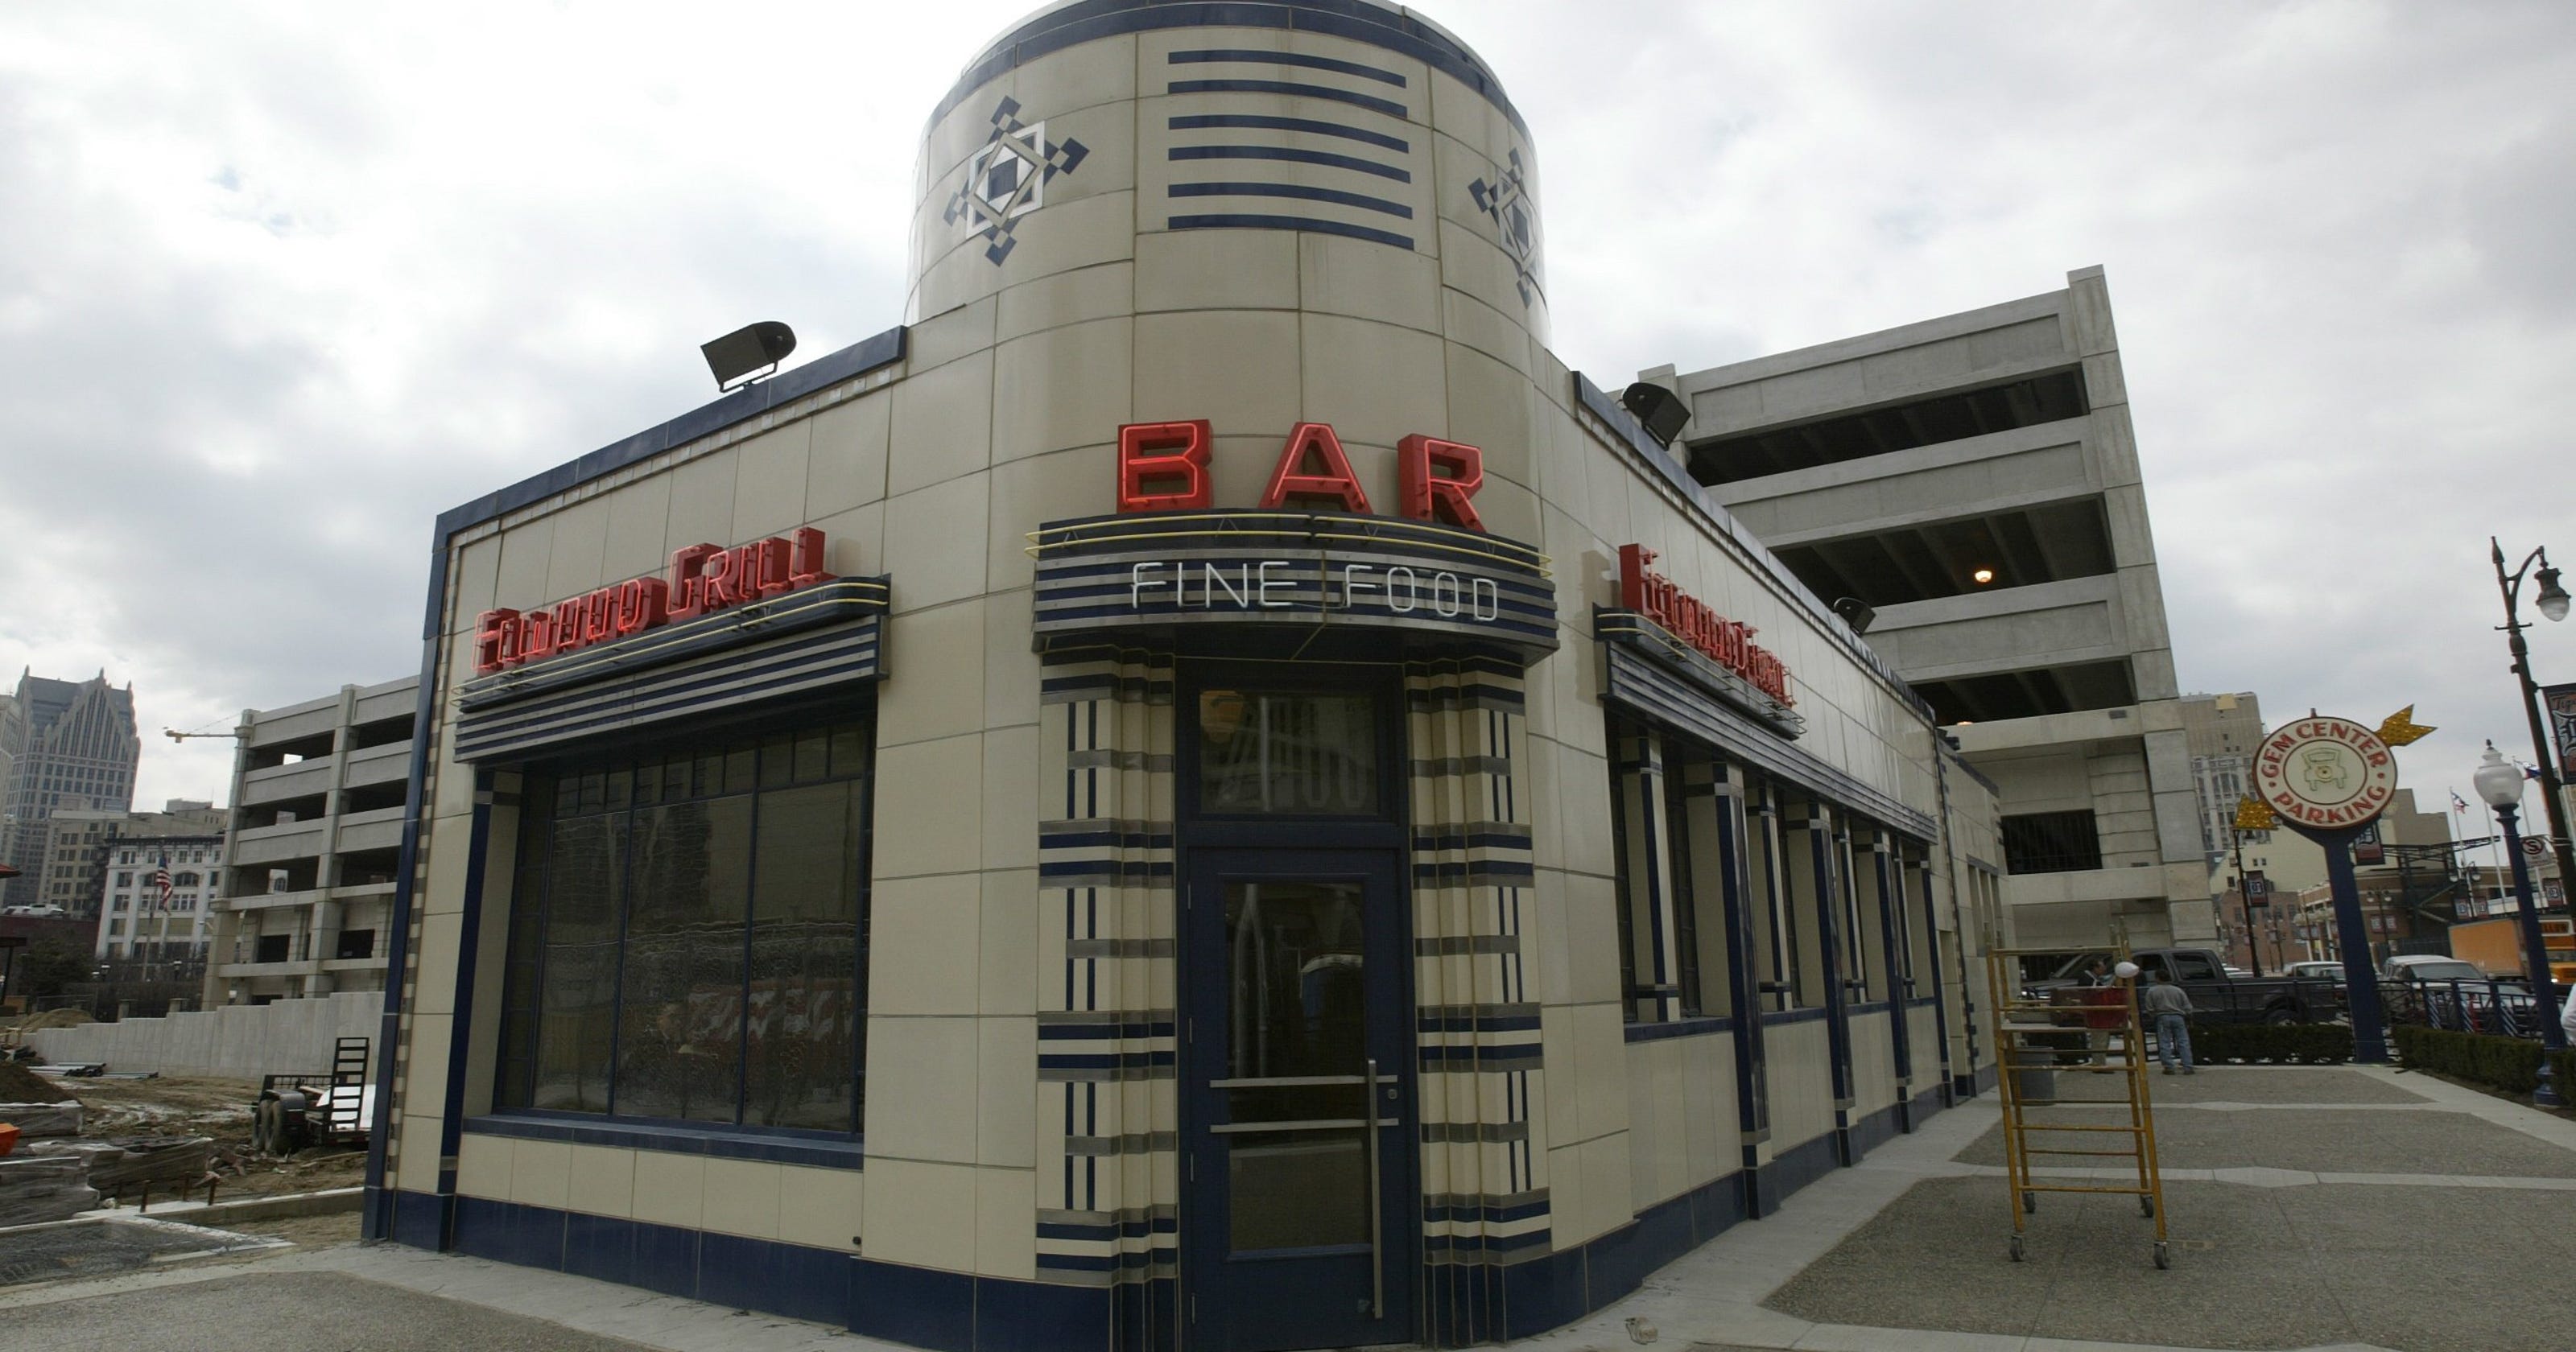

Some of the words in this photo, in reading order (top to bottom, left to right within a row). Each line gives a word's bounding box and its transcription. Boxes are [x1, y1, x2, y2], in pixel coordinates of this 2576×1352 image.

[1117, 418, 1488, 533] BAR
[666, 526, 836, 622] GRILL
[1132, 562, 1297, 609] FINE
[1344, 564, 1498, 621] FOOD
[2261, 733, 2297, 778] GEM
[2296, 722, 2388, 768] CENTER
[2273, 785, 2386, 824] PARKING
